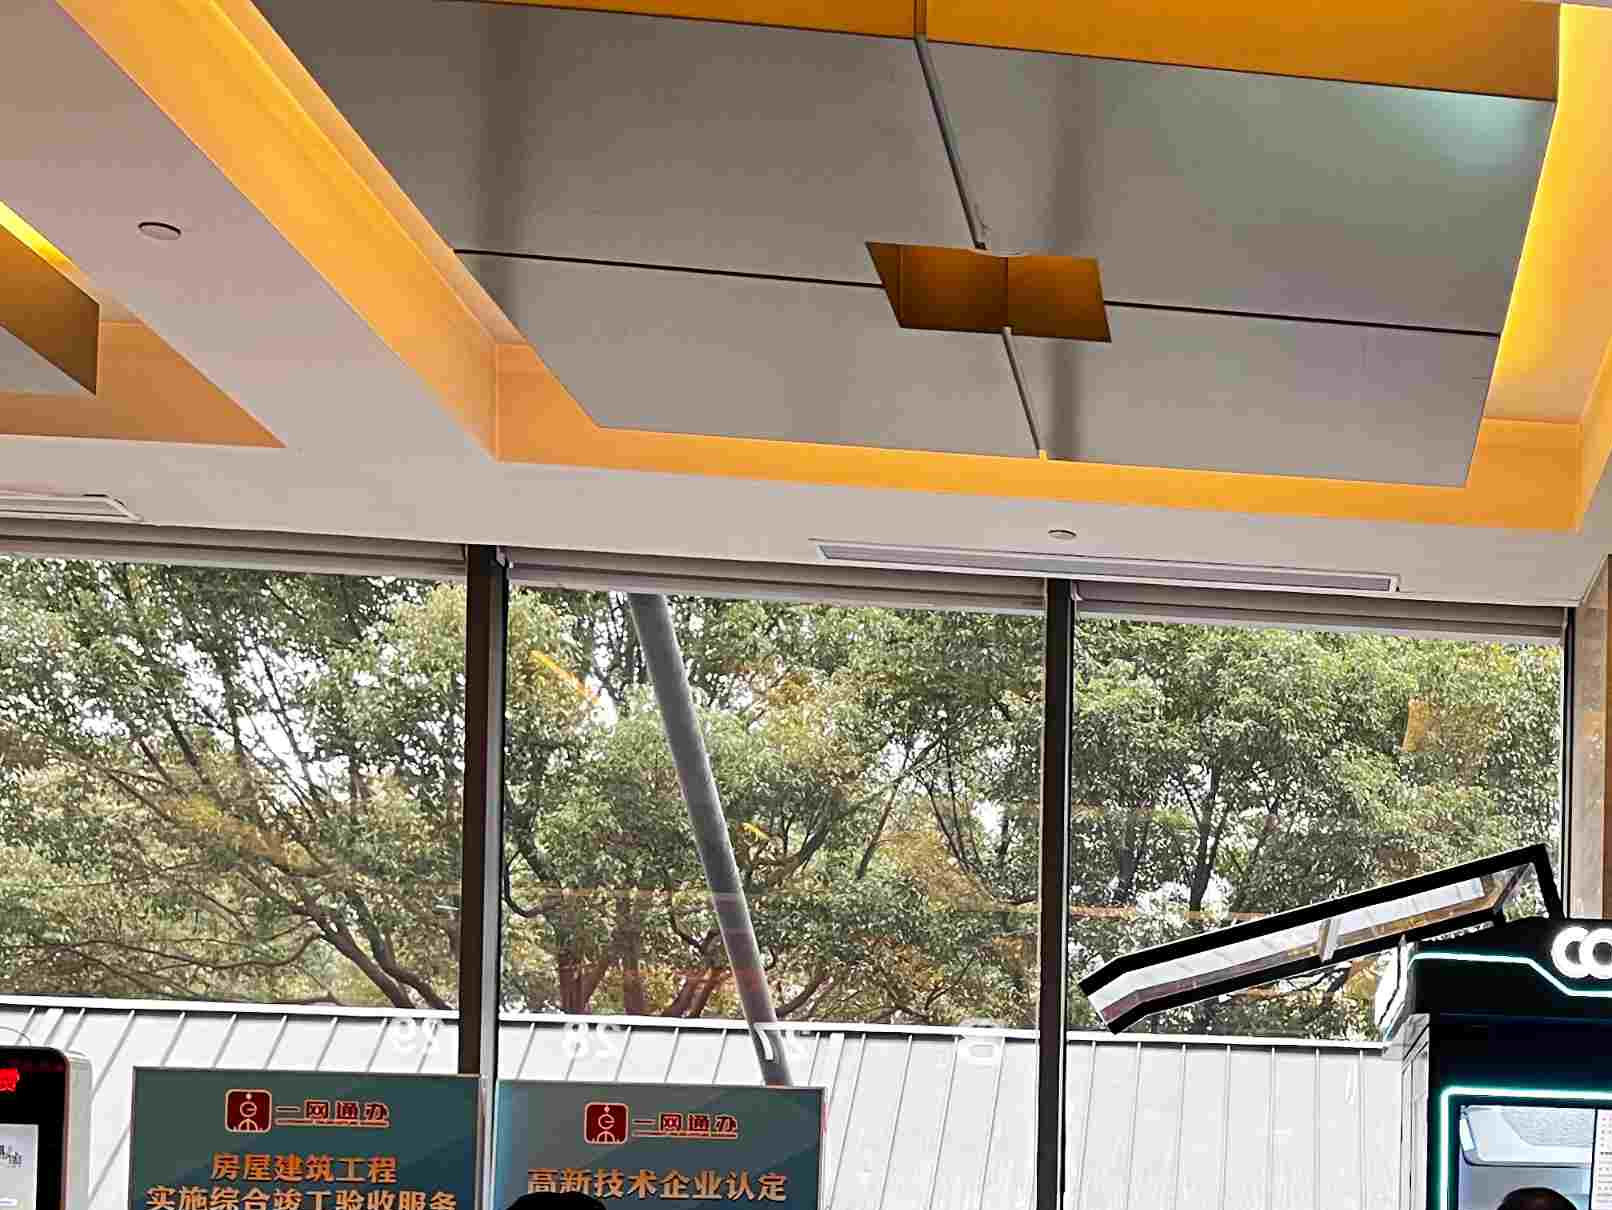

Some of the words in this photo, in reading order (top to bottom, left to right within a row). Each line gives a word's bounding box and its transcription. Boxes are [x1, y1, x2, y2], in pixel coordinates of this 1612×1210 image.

[275, 1098, 390, 1121] 一网通办
[632, 1111, 739, 1134] 一网通办
[209, 1152, 399, 1184] 房屋建筑工程
[527, 1167, 788, 1202] 高新技术企业认定
